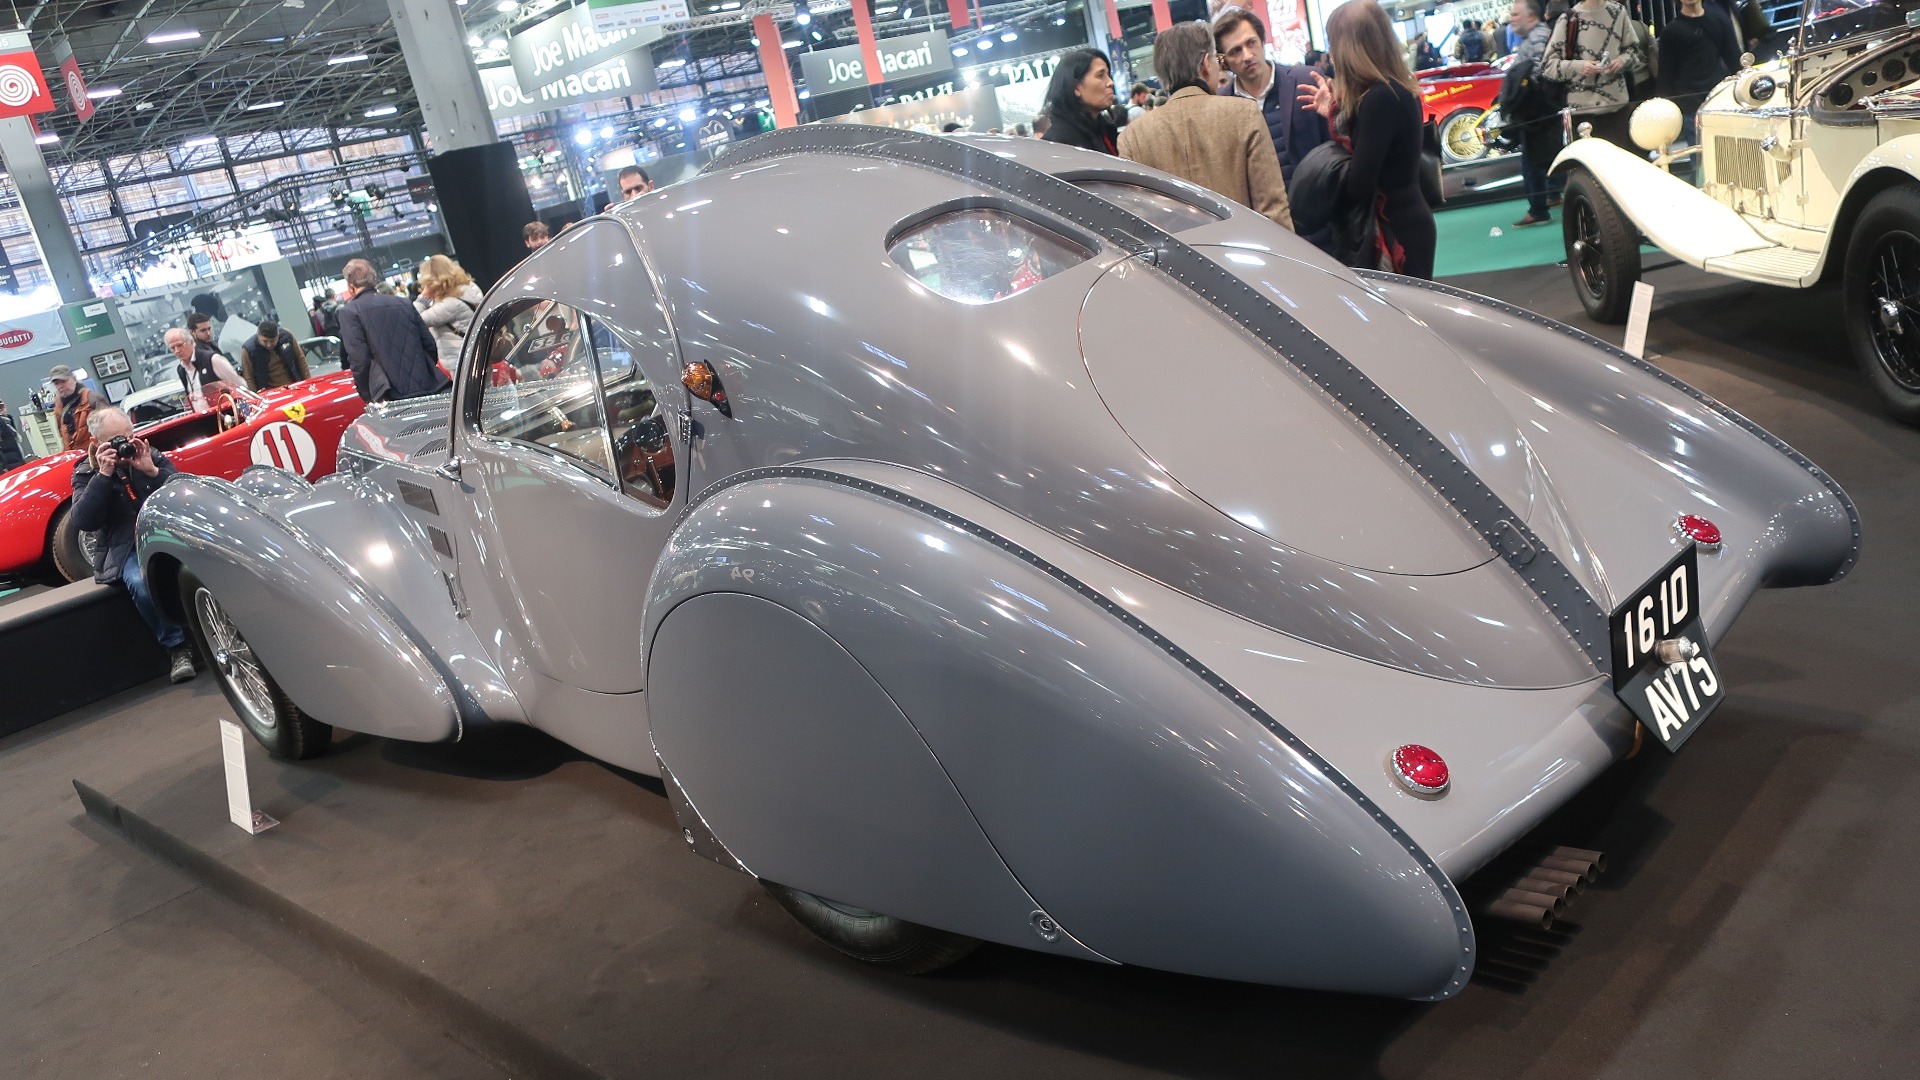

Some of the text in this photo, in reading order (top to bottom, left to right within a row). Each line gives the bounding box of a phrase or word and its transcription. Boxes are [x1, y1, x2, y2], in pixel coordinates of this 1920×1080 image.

[529, 40, 564, 76] Joe
[541, 59, 632, 100] Macari
[828, 40, 933, 84] Joe acari
[262, 424, 305, 476] 11
[1623, 564, 1689, 669] 1610
[1644, 641, 1718, 742] AV75
